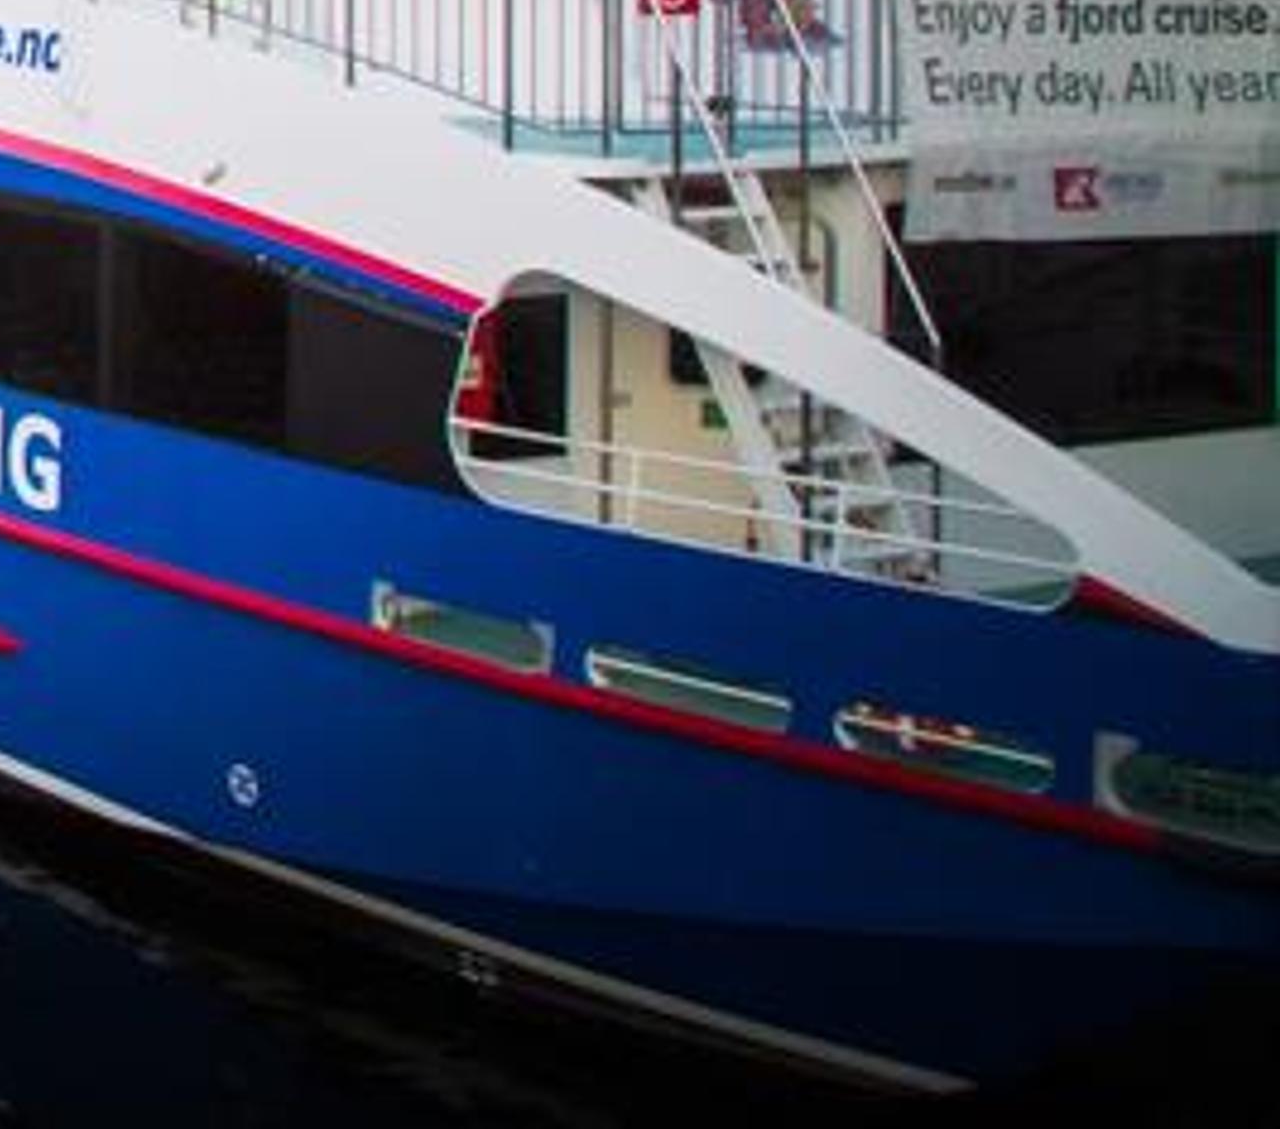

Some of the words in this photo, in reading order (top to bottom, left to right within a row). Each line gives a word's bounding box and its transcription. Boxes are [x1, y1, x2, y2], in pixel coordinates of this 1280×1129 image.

[1025, 0, 1047, 36] a
[923, 56, 1023, 117] Every
[1034, 60, 1117, 117] day.
[1124, 60, 1178, 104] All
[1190, 68, 1280, 116] year
